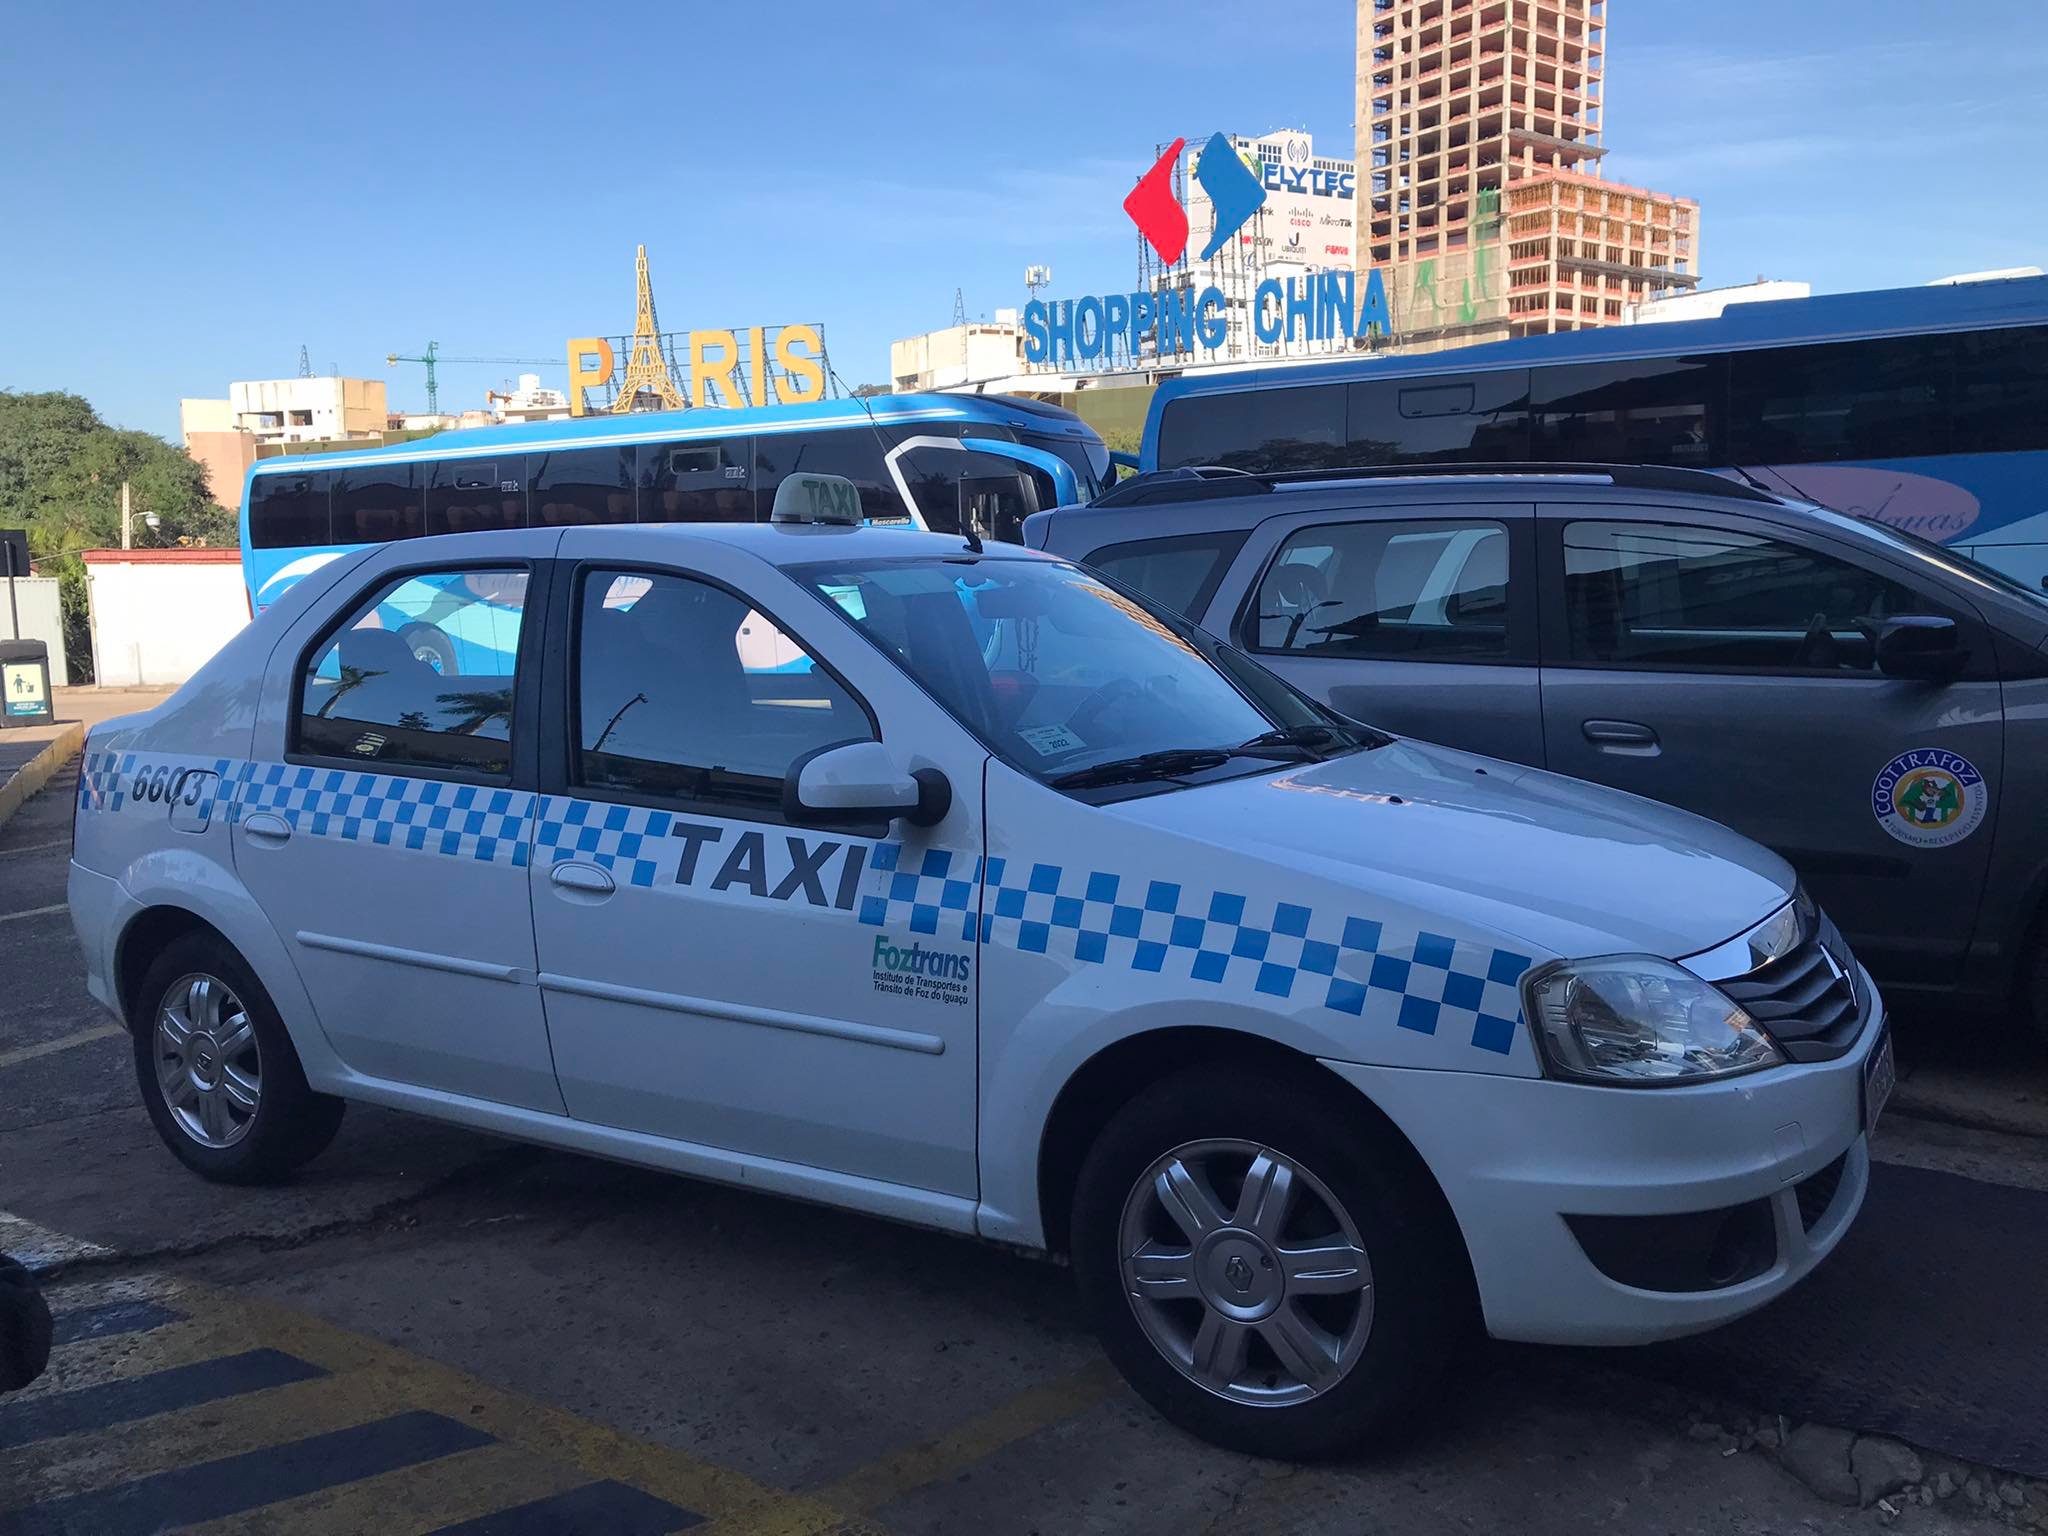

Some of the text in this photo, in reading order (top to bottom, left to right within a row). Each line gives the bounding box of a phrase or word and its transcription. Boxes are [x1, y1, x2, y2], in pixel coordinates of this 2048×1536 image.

[1290, 218, 1311, 227] CISCO
[1282, 245, 1306, 254] UBIQUITI
[1024, 268, 1392, 364] SHOPPING CHINA
[801, 480, 856, 516] TAXI
[132, 765, 207, 806] 6603
[1875, 751, 1979, 815] COOTTRAFOZ
[671, 821, 868, 911] TAXI
[872, 934, 970, 981] Foztrans
[873, 970, 968, 993] Instituto de Transportes e
[873, 980, 969, 1007] Trânsito de Foz do Iguaçu
